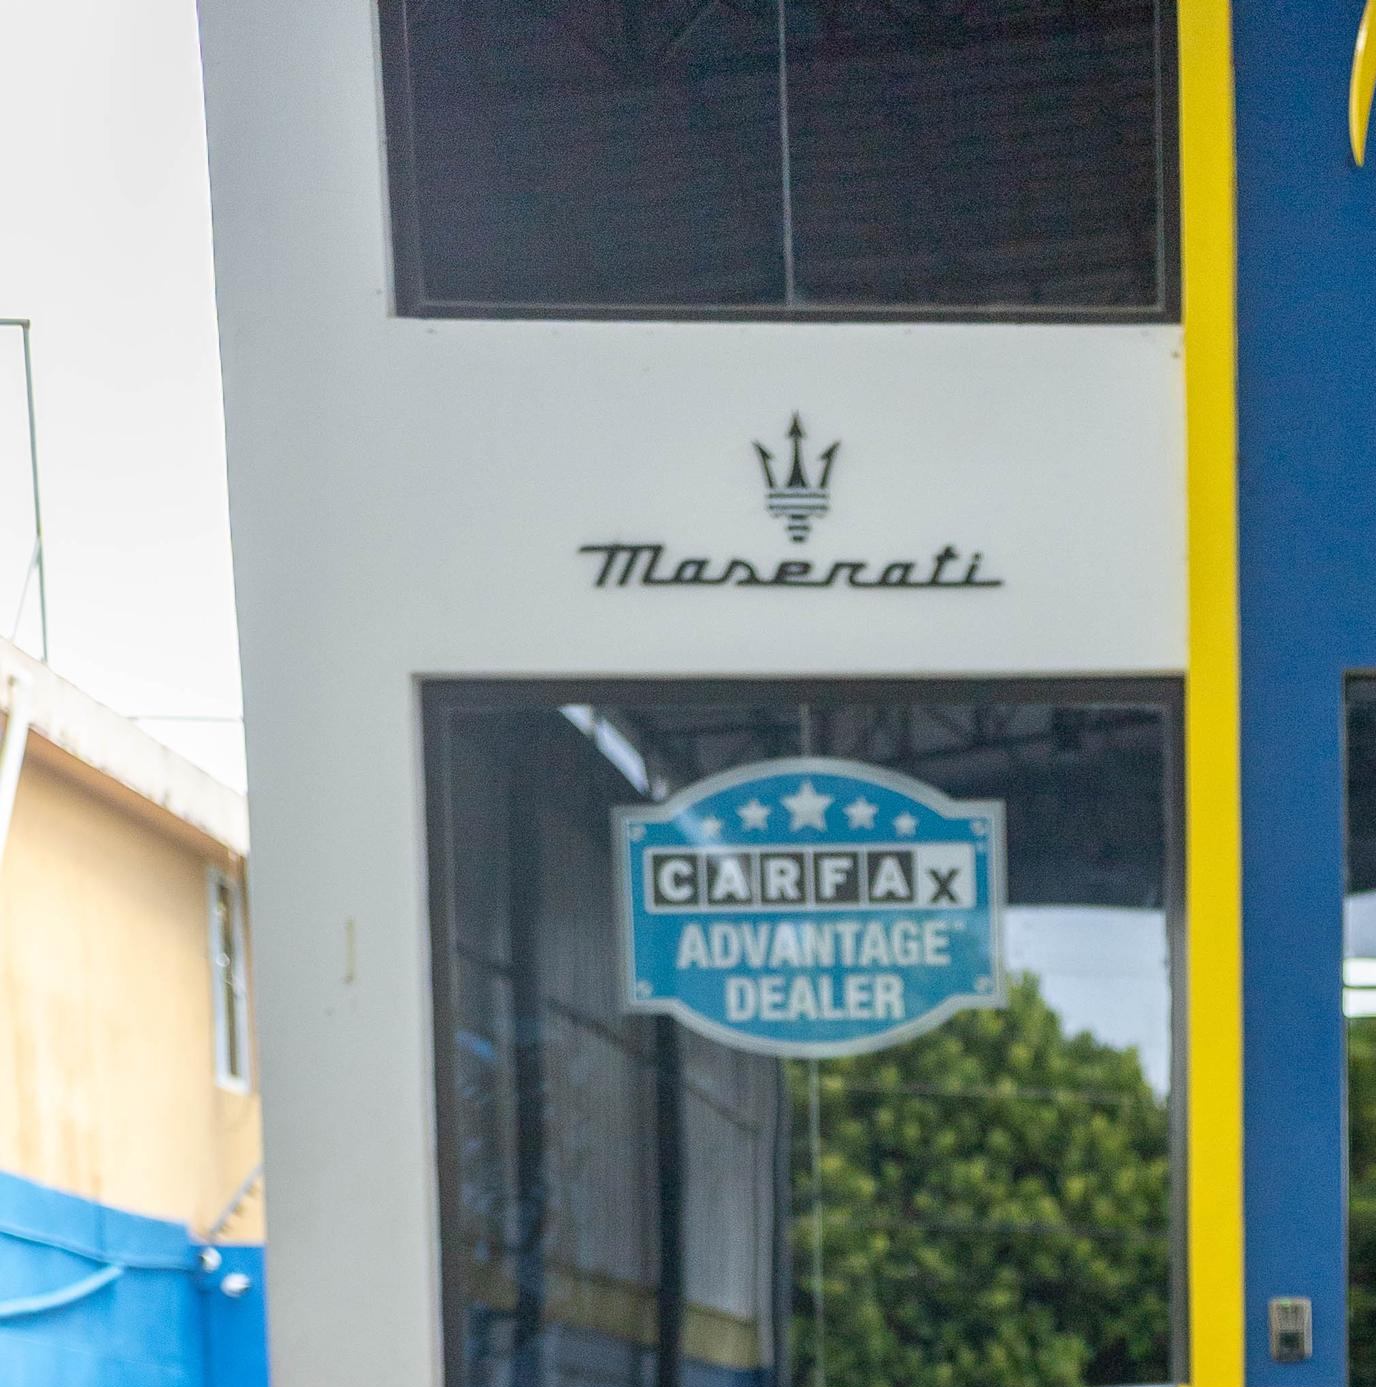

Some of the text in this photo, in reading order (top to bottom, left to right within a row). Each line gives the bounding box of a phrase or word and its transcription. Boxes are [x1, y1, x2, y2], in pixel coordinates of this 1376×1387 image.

[578, 543, 1005, 588] Maserati
[660, 857, 961, 905] CARFAX
[676, 920, 951, 969] ADVANTAGE
[725, 973, 906, 1022] DEALER
